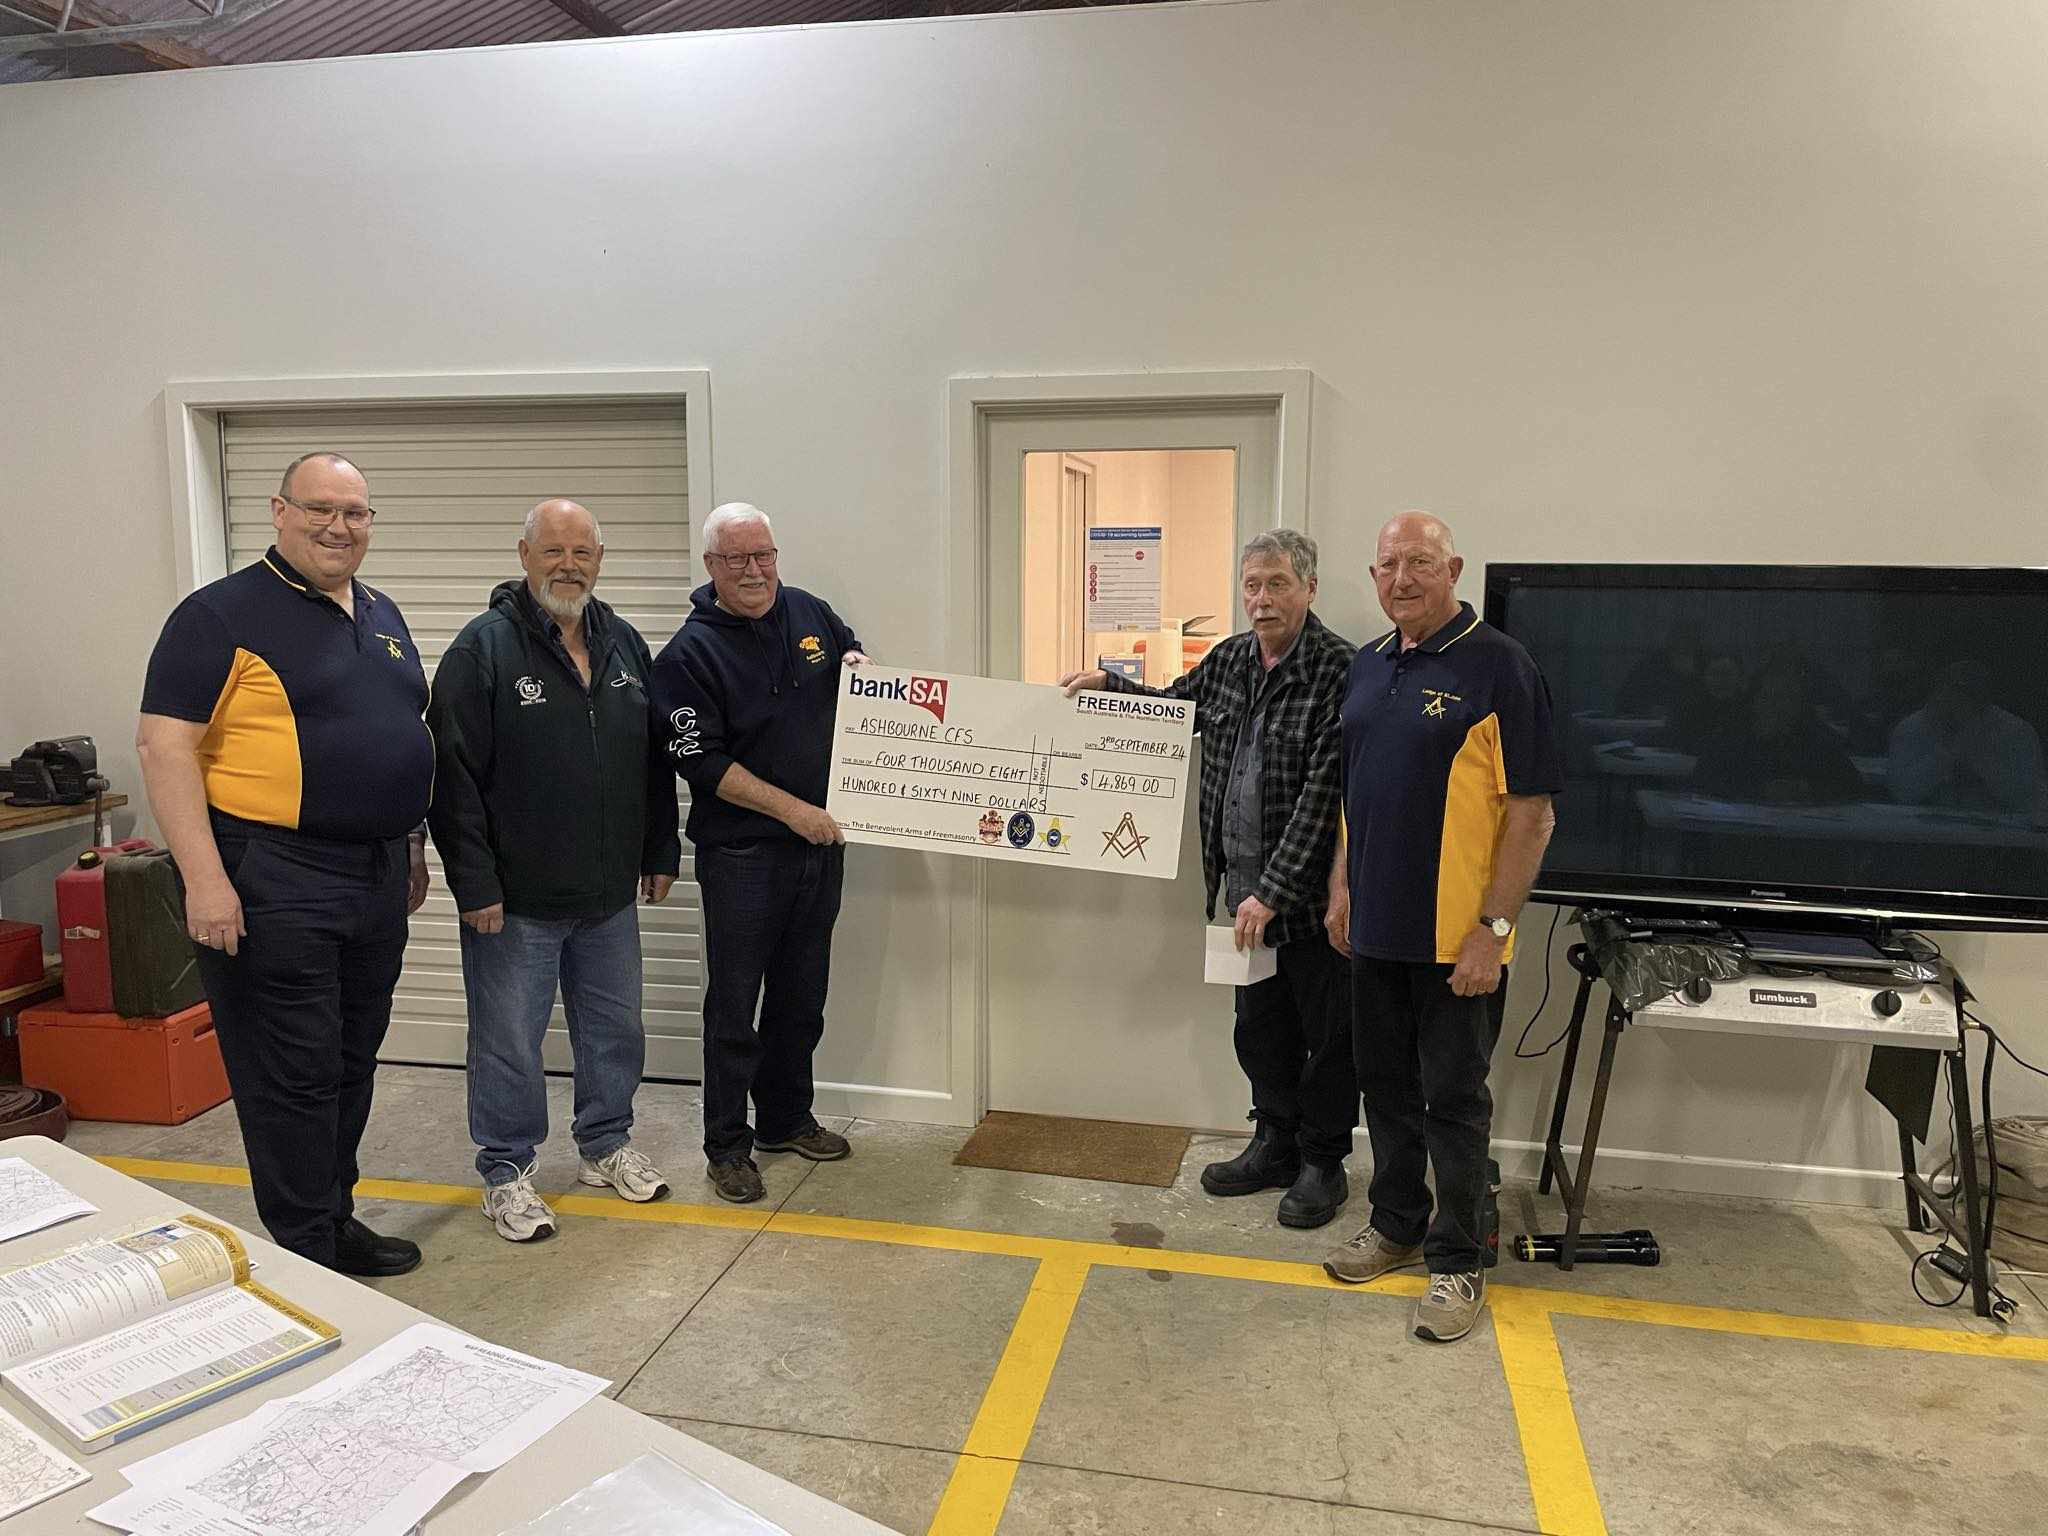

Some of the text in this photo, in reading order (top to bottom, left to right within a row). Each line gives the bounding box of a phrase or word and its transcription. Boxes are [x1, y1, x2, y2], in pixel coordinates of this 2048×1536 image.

[1078, 695, 1185, 719] FREEMASONS
[861, 717, 973, 744] ASHBOURNE CFS
[1114, 739, 1167, 755] SEPTEMBER
[1171, 744, 1185, 760] 24
[876, 751, 1028, 781] FOUR THOUSAND EIGHT
[1080, 773, 1088, 786] $
[842, 776, 897, 794] HUNDRED
[911, 785, 947, 799] SIXTY
[952, 790, 983, 804] NINE
[988, 795, 1047, 813] DOLLARS
[852, 821, 864, 829] The
[865, 822, 904, 833] Benevolent
[933, 830, 977, 842] Freemasonry
[1755, 993, 1809, 1005] jumbuck
